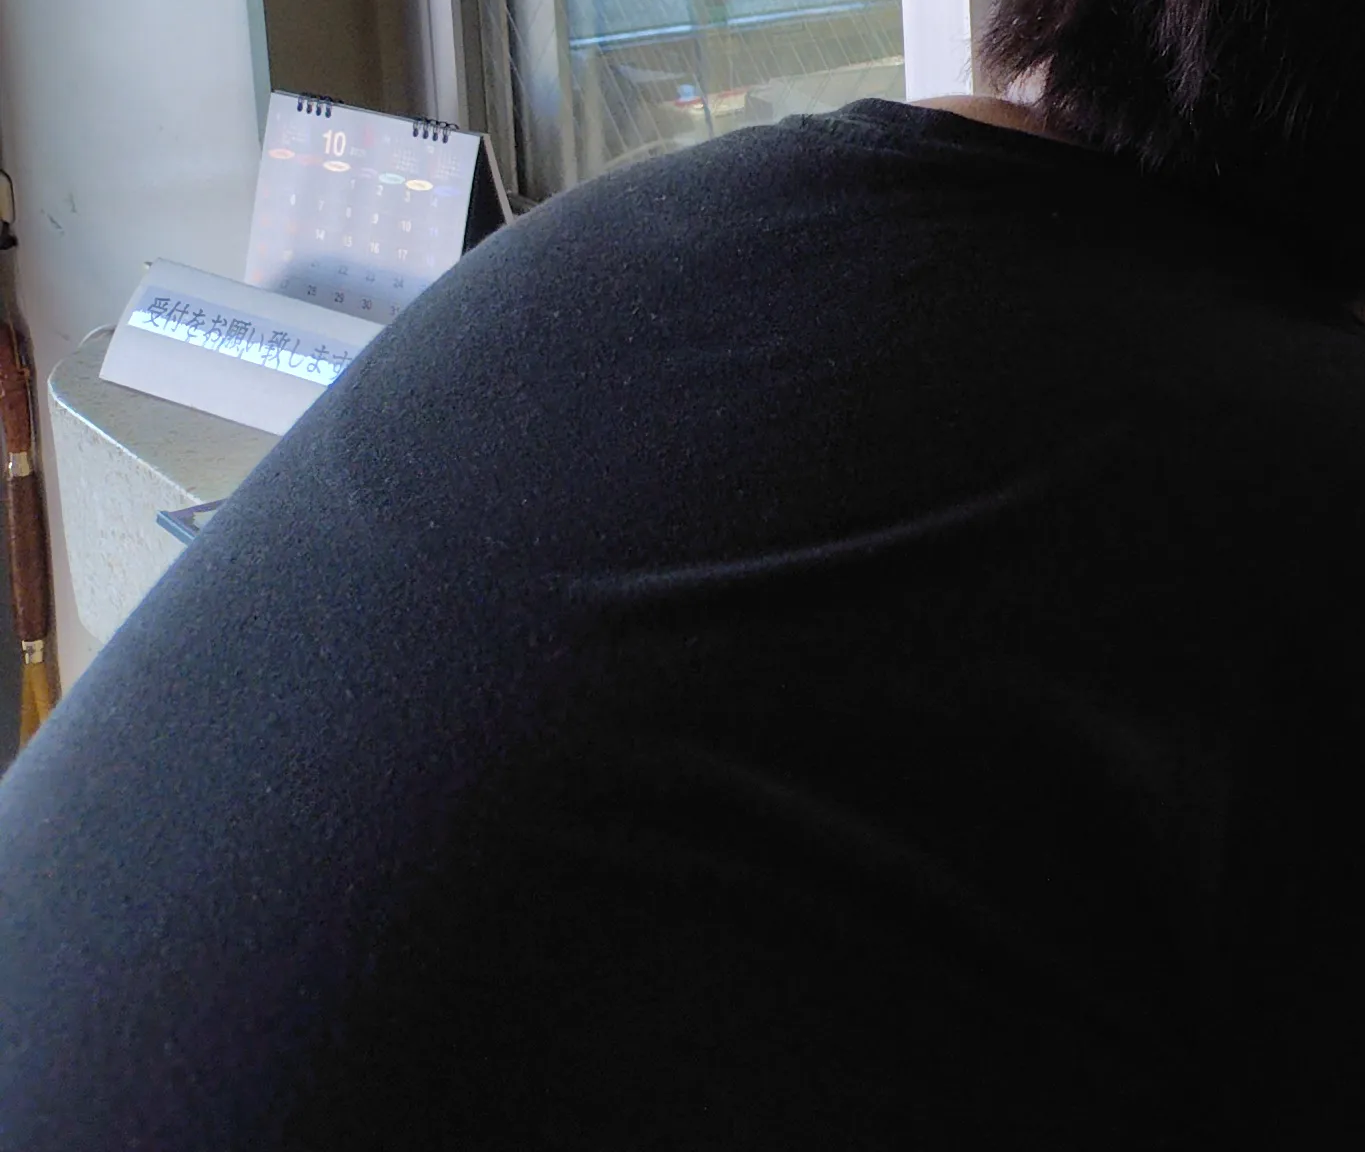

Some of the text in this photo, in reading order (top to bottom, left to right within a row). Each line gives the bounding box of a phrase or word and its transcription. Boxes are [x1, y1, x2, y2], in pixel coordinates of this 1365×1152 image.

[322, 129, 347, 157] 10
[376, 185, 384, 197] 2
[318, 199, 325, 212] 7
[401, 220, 412, 233] 10
[315, 228, 326, 241] 14
[369, 241, 380, 254] 16
[397, 249, 408, 262] 17
[362, 298, 373, 311] 30
[143, 297, 352, 380] 受付をお願い致します
